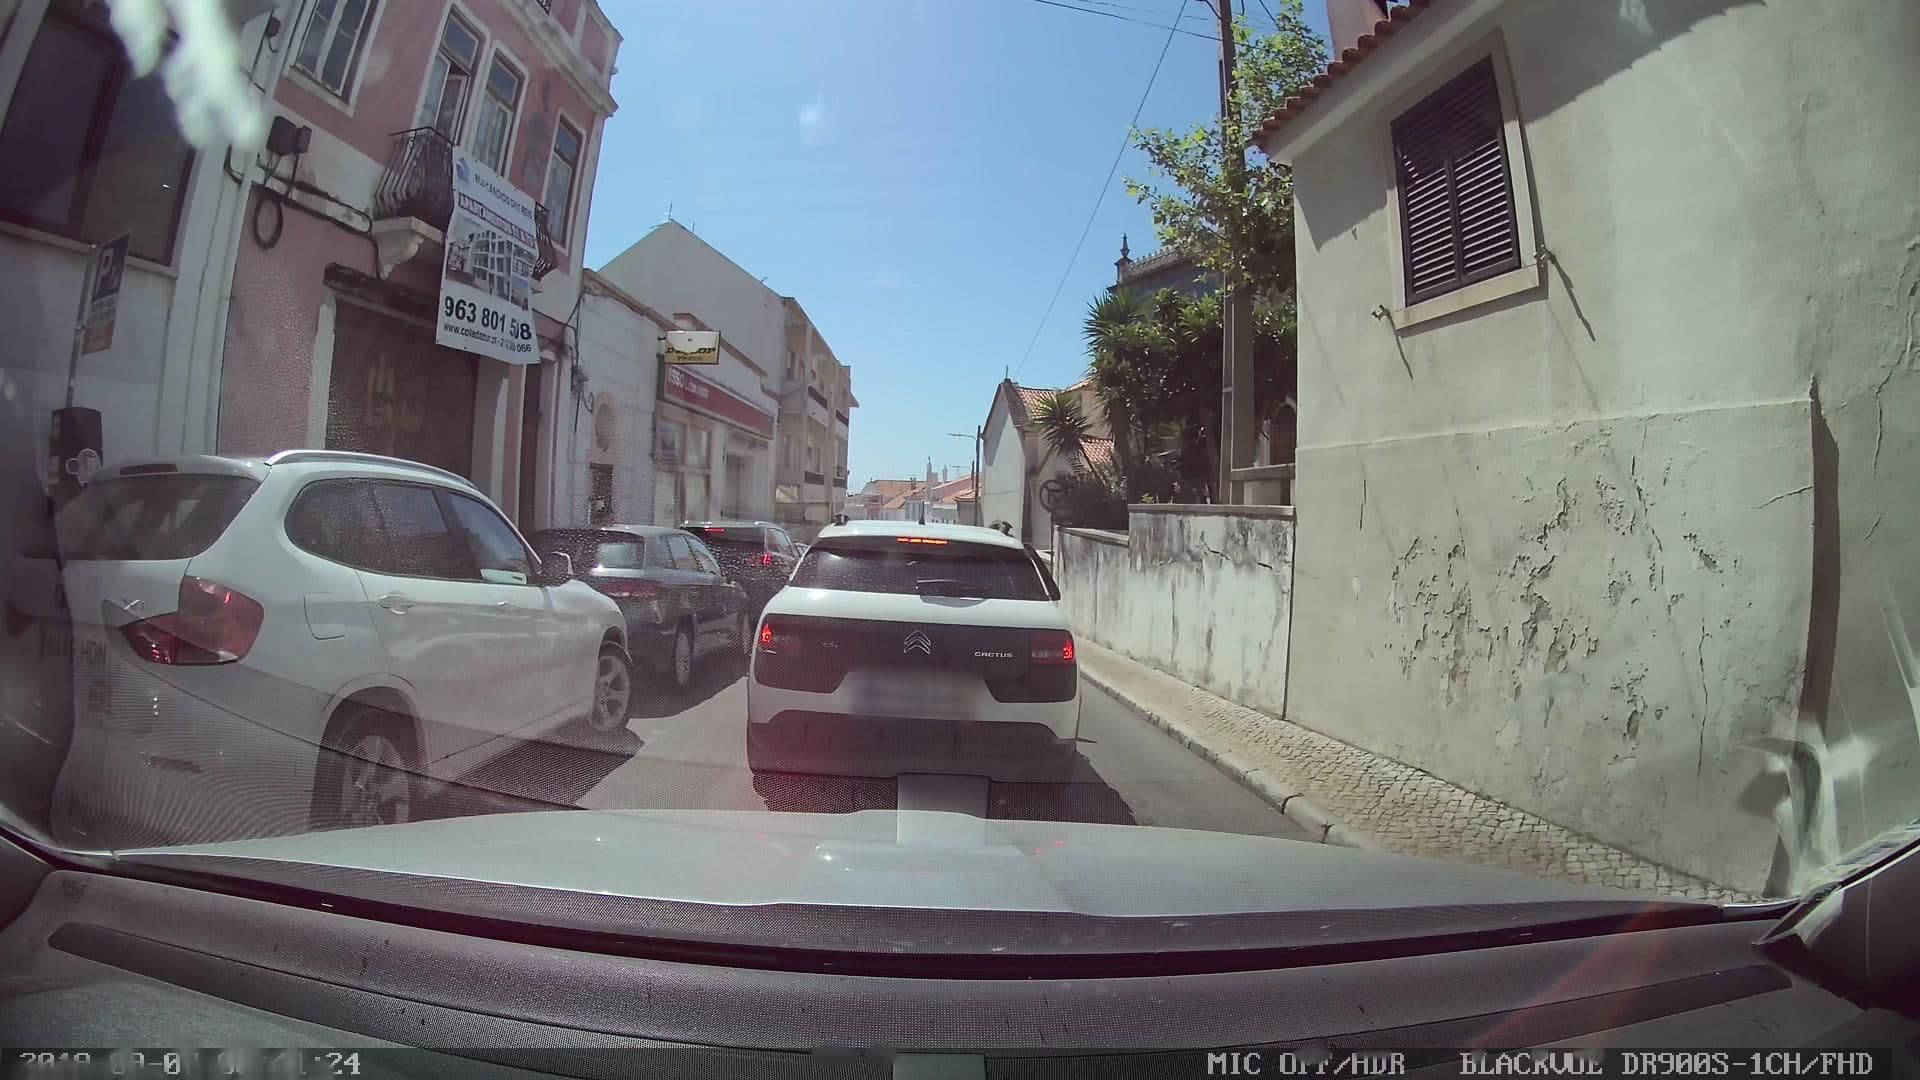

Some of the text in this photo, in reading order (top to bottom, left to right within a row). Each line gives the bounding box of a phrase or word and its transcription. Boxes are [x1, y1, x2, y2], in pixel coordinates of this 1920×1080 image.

[444, 296, 477, 323] 963
[481, 307, 506, 333] 801
[974, 651, 1013, 659] CACTUS
